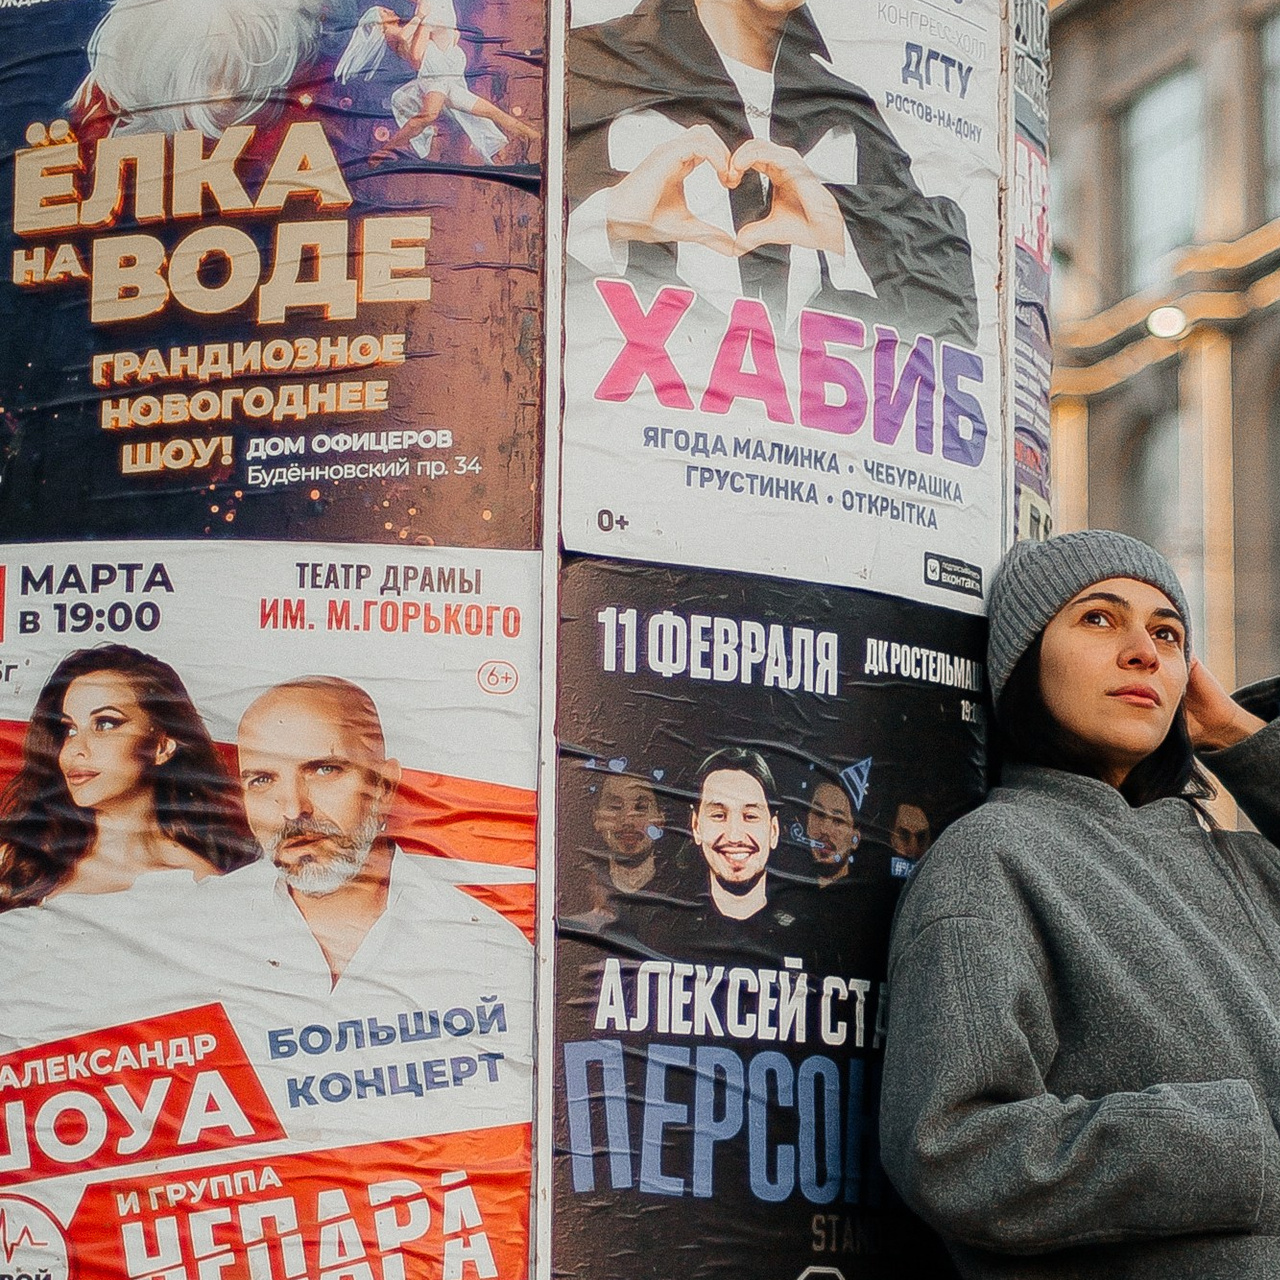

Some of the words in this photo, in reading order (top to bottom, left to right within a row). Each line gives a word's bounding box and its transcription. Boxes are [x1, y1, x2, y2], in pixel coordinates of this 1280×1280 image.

[901, 39, 974, 100] ДГТУ
[885, 90, 983, 144] РОСТОВ-НА-ДОНУ
[13, 119, 355, 237] ЁЛКА
[12, 242, 88, 286] НА
[90, 216, 433, 326] ВОДЕ
[92, 333, 407, 387] ГРАНДИОЗНОЕ
[593, 278, 988, 469] ХАБИБ
[101, 379, 390, 429] НОВОГОДНЕЕ
[121, 436, 234, 475] ШОУ!
[246, 434, 305, 461] ДОМ
[311, 429, 454, 455] ОФИЦЕРОВ
[247, 457, 411, 487] Будённовский
[416, 460, 449, 479] пр.
[453, 455, 483, 477] 34
[643, 424, 729, 460] ЯГОДА
[731, 437, 840, 477] МАЛИНКА
[863, 458, 964, 505] ЧЕБУРАШКА
[596, 507, 630, 533] 0+
[685, 463, 820, 506] ГРУСТИНКА
[841, 487, 939, 531] ОТКРЫТКА
[19, 562, 175, 596] МАРТА
[295, 562, 372, 590] ТЕАТР
[378, 564, 483, 596] ДРАМЫ
[53, 600, 161, 634] 19:00
[259, 597, 316, 631] ИМ.
[325, 599, 521, 639] М.ГОРЬКОГО
[485, 667, 514, 688] 6+
[597, 606, 637, 675] 11
[646, 609, 839, 697] ФЕВРАЛЯ
[864, 637, 889, 676] ДК
[594, 956, 808, 1043] АЛЕКСЕЙ
[267, 995, 507, 1061] БОЛЬШОЙ
[0, 1034, 218, 1091] АЛЕКСАНДР
[286, 1051, 505, 1110] КОНЦЕРТ
[117, 1191, 140, 1217] И
[149, 1165, 283, 1211] ГРУППА
